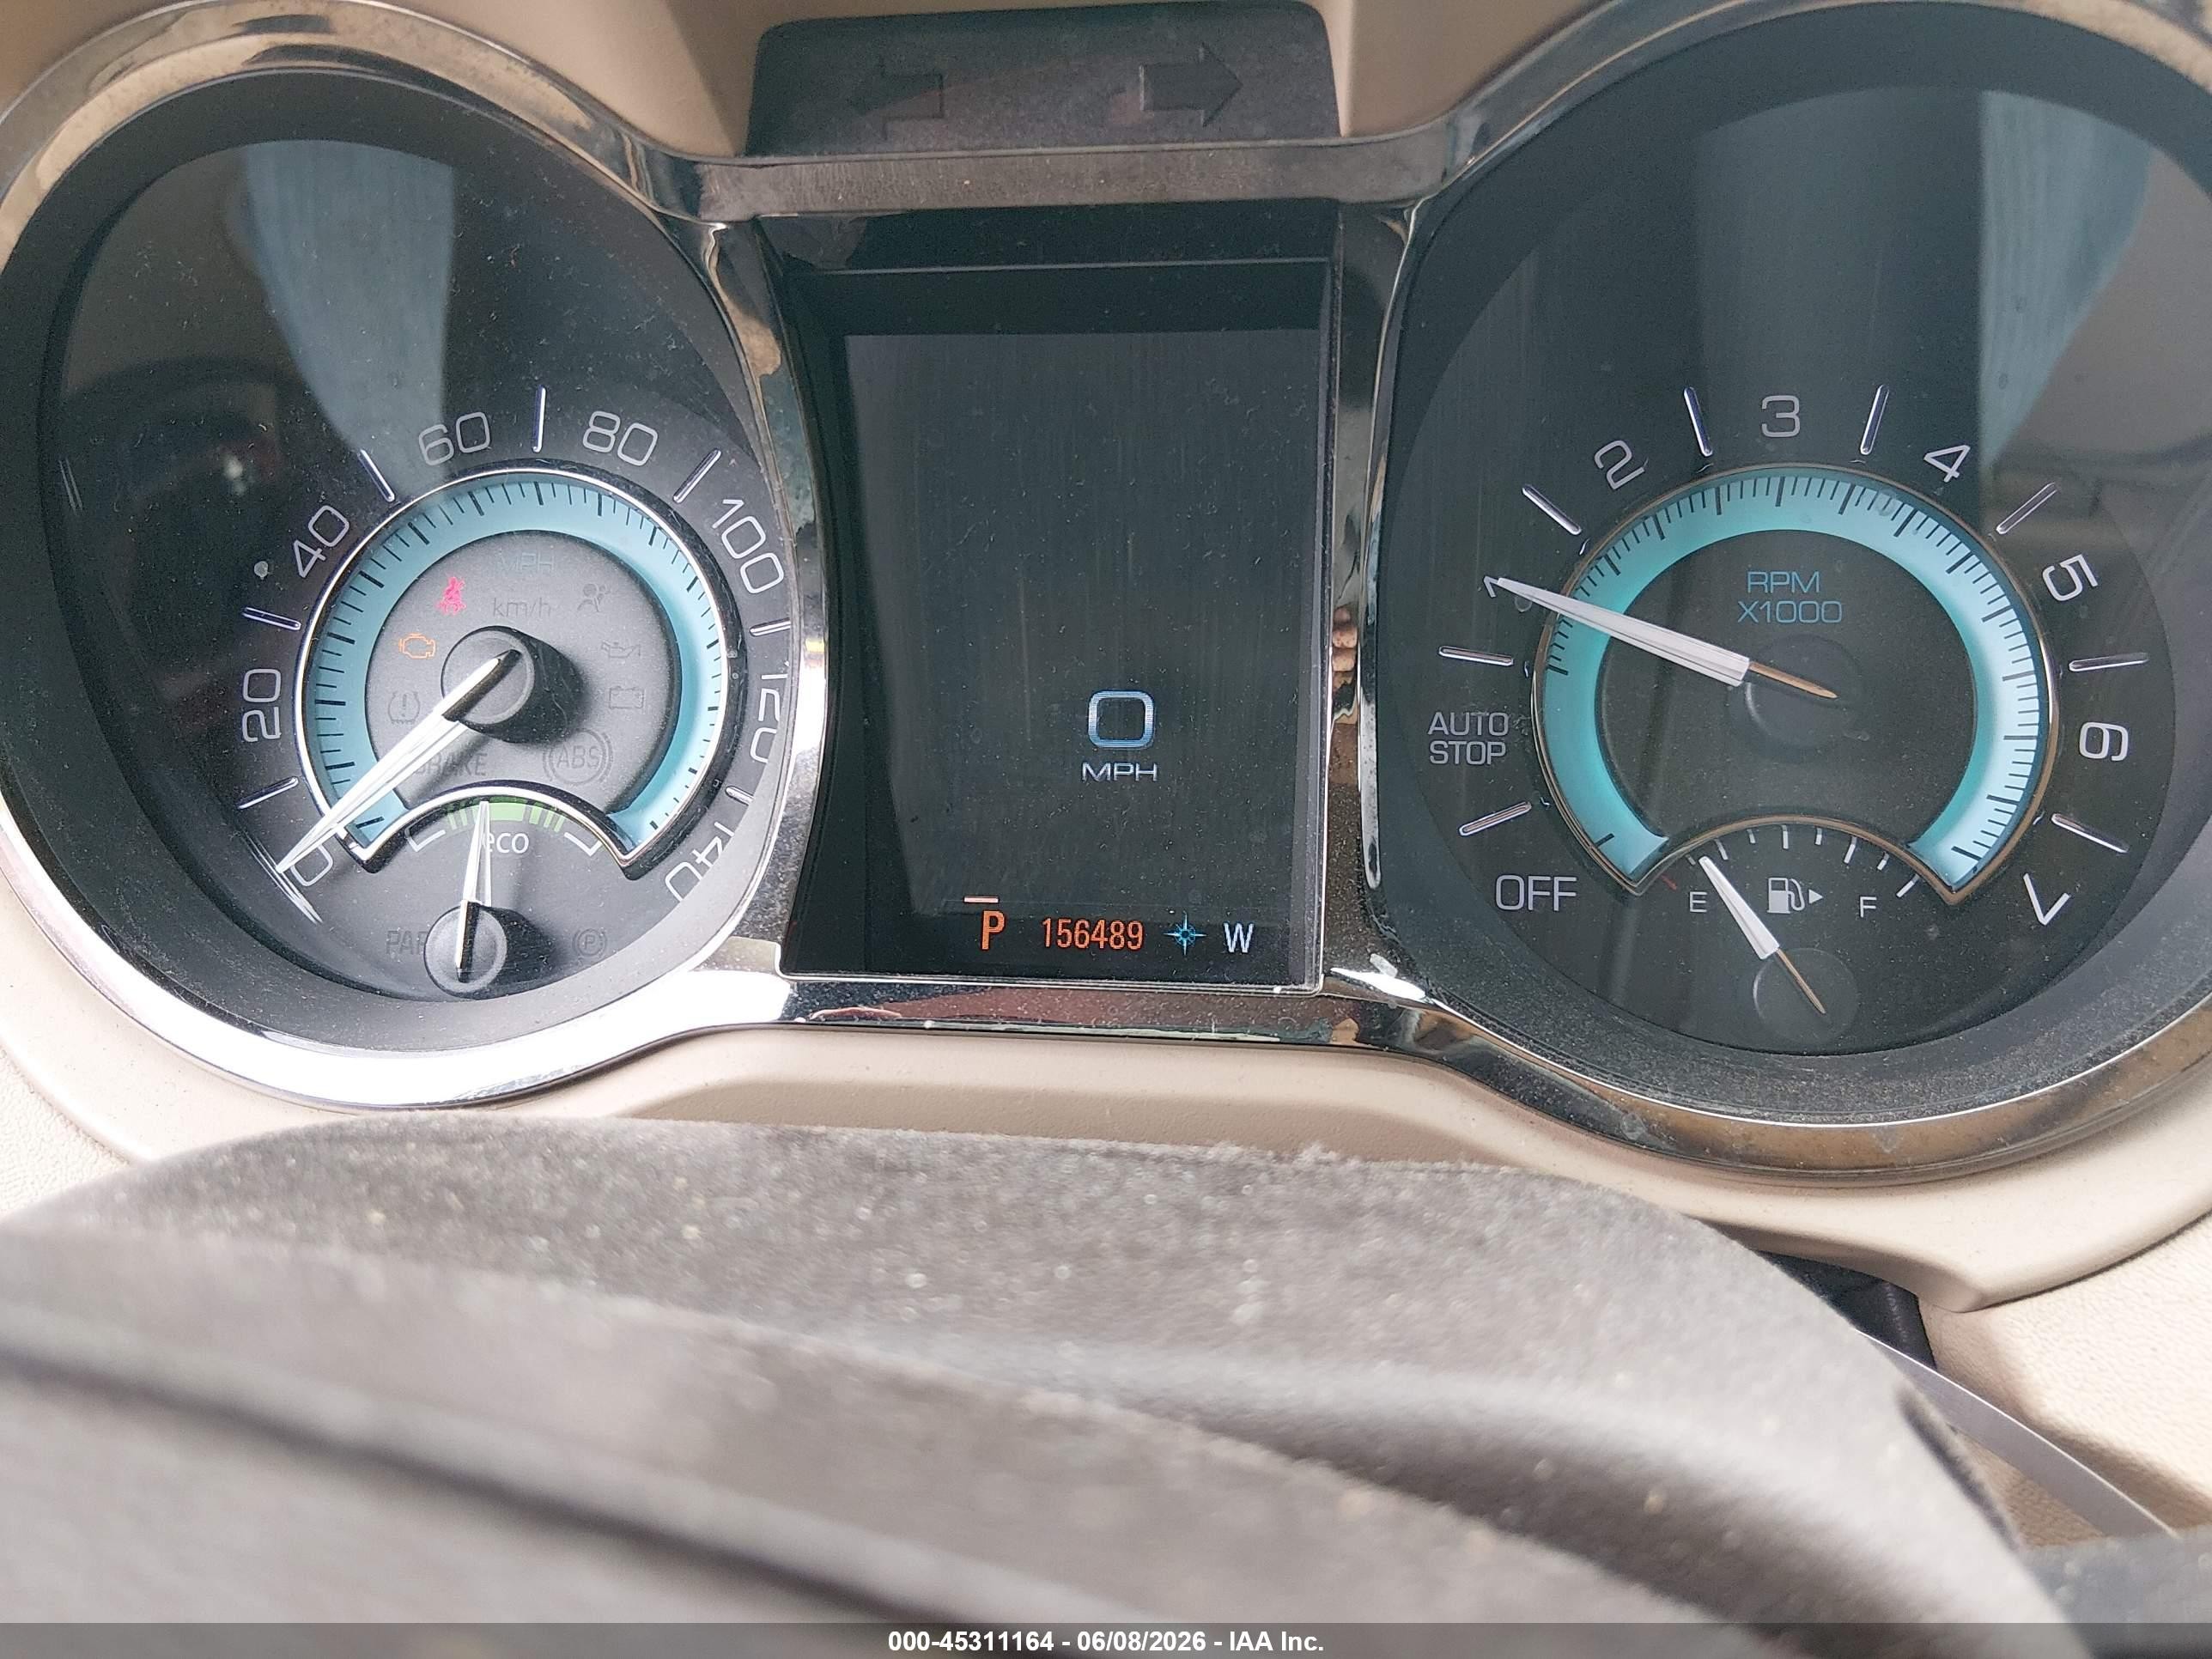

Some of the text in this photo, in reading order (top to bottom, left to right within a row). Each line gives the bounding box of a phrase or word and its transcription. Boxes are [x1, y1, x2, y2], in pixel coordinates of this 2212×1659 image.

[1760, 394, 1801, 439] 3
[418, 411, 491, 465] 60
[582, 410, 659, 467] 80
[1593, 440, 1646, 490] 2
[1923, 444, 1972, 483] 4
[293, 505, 350, 579] 40
[711, 499, 785, 594] 100
[1746, 570, 1821, 593] RPM
[2041, 553, 2099, 602] 5
[492, 597, 551, 617] km/h
[1737, 600, 1843, 623] X1000
[241, 667, 282, 743] 20
[1087, 690, 1155, 749] 0
[1427, 711, 1510, 737] AUTO
[556, 745, 601, 770] ABS
[1429, 740, 1506, 765] STOP
[2078, 721, 2130, 762] 6
[1081, 762, 1158, 782] MPH
[481, 832, 530, 854] eco
[1495, 874, 1578, 912] OFF
[1689, 891, 1708, 914] E
[1859, 896, 1878, 918] F
[2022, 872, 2071, 926] 7
[981, 909, 1006, 951] P
[1041, 917, 1145, 951] 156489
[1223, 922, 1255, 953] W
